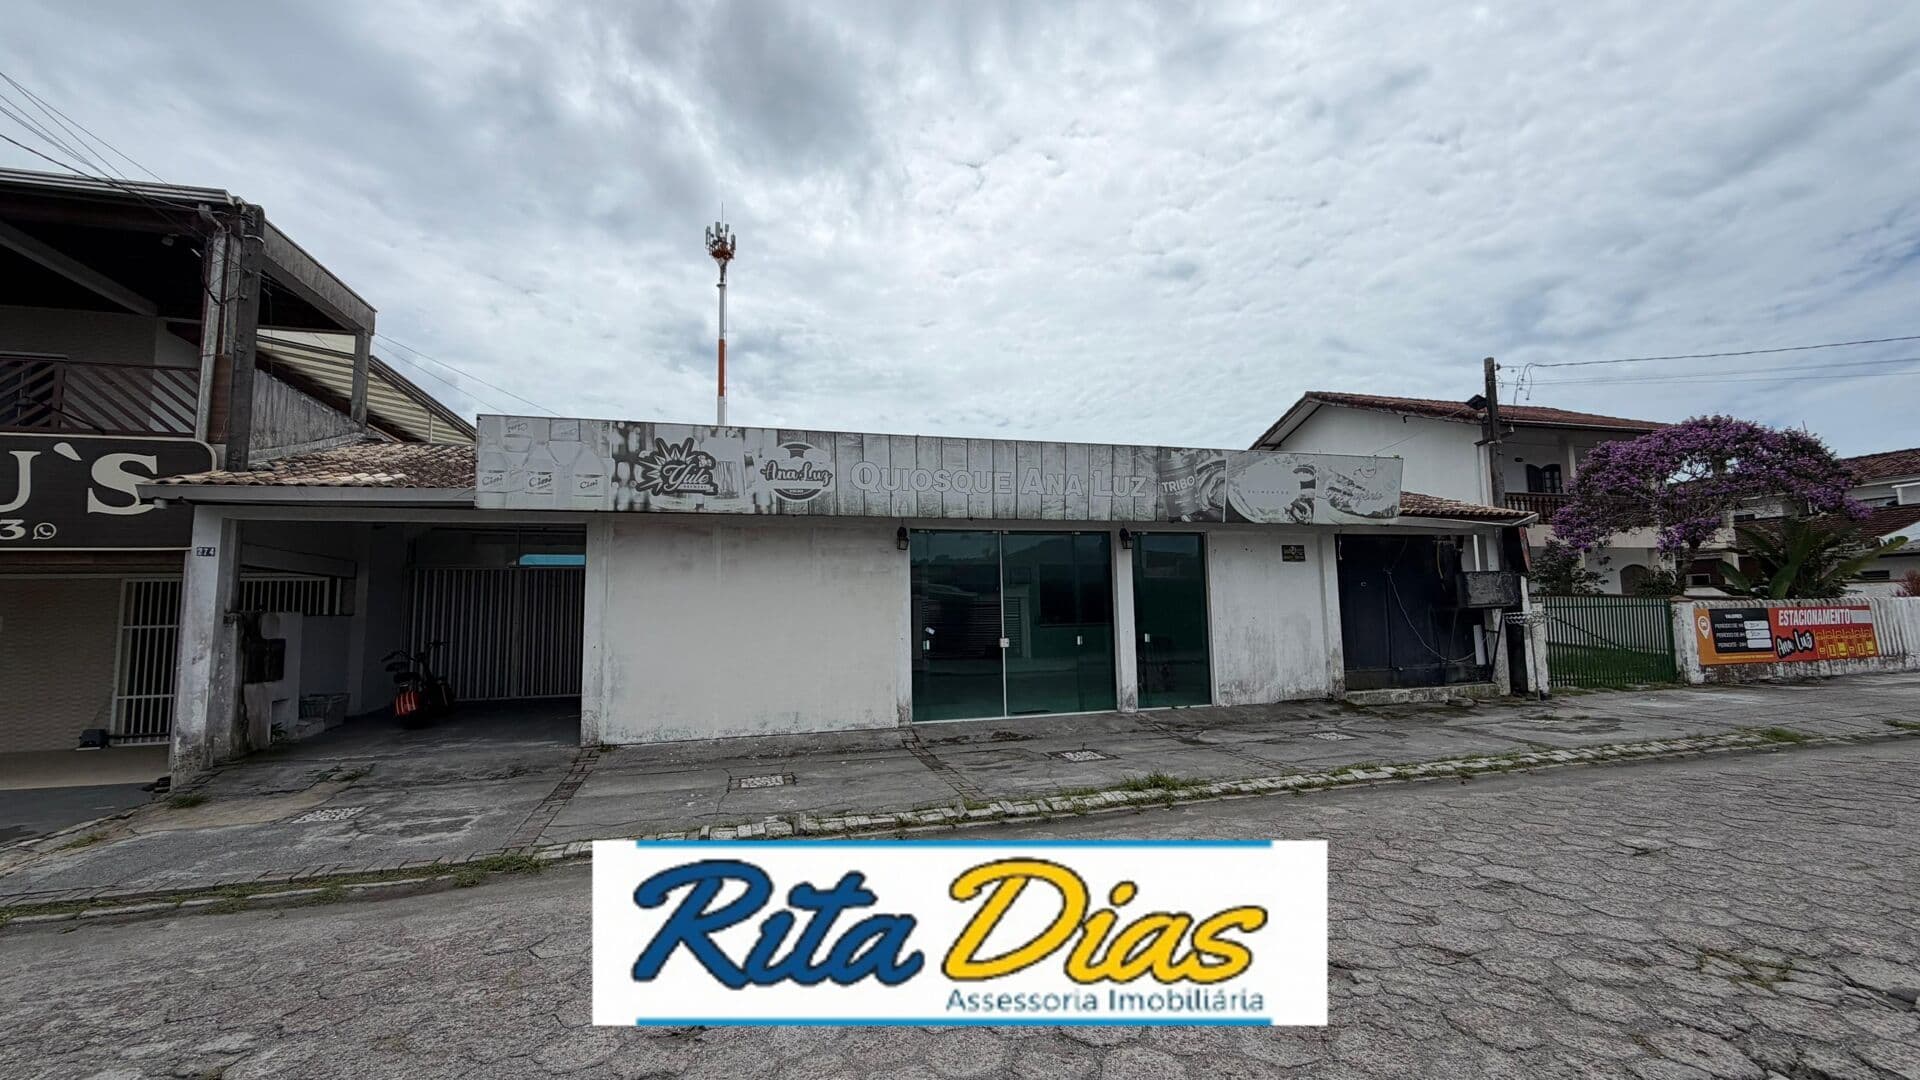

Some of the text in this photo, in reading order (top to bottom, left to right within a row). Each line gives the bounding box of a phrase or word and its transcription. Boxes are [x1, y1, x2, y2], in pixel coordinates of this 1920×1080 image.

[850, 461, 1147, 498] QUIOSQUE ANA LUZ
[1162, 476, 1195, 492] TRIBO
[1778, 608, 1851, 626] ESTACIONAMENTO
[1776, 637, 1795, 656] Ana
